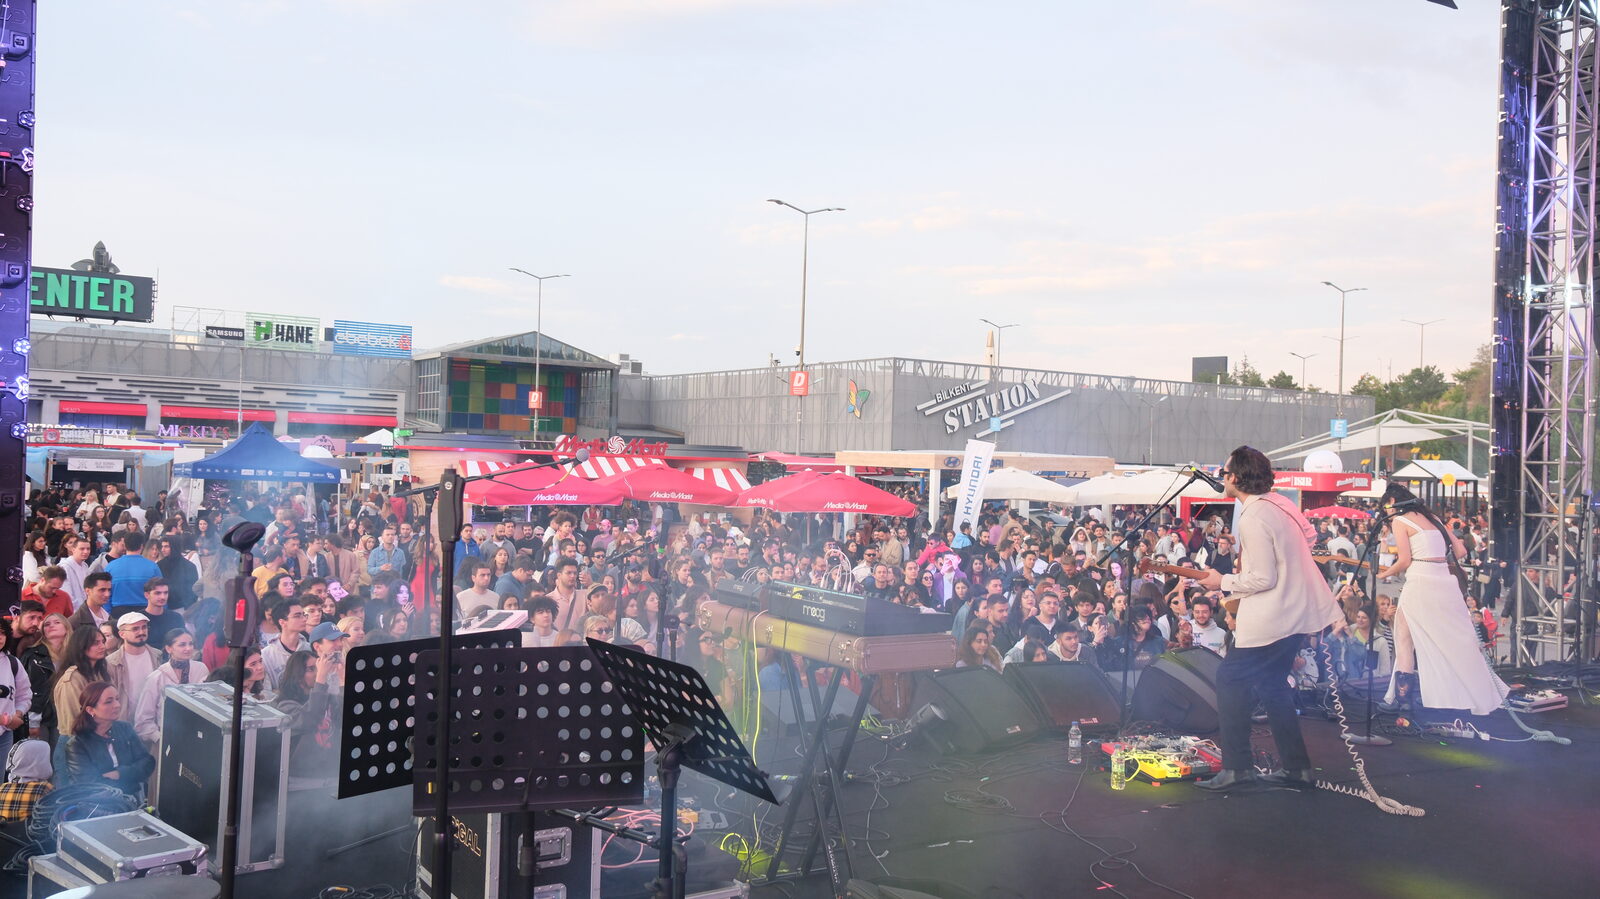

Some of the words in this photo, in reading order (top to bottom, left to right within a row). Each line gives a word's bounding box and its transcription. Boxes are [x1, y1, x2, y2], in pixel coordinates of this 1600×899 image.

[30, 271, 135, 314] ENTER
[207, 329, 244, 338] SAMSUNG
[275, 323, 314, 344] HANE
[793, 372, 805, 387] D
[530, 392, 539, 403] D
[944, 377, 1041, 435] STATION
[1335, 421, 1345, 432] E
[553, 434, 609, 454] Media
[622, 437, 669, 457] Markt
[963, 455, 983, 515] HYUNDAI
[533, 493, 555, 501] Media
[650, 491, 671, 499] Media
[672, 492, 693, 500] Markt
[823, 501, 845, 509] Media
[802, 604, 826, 622] moog
